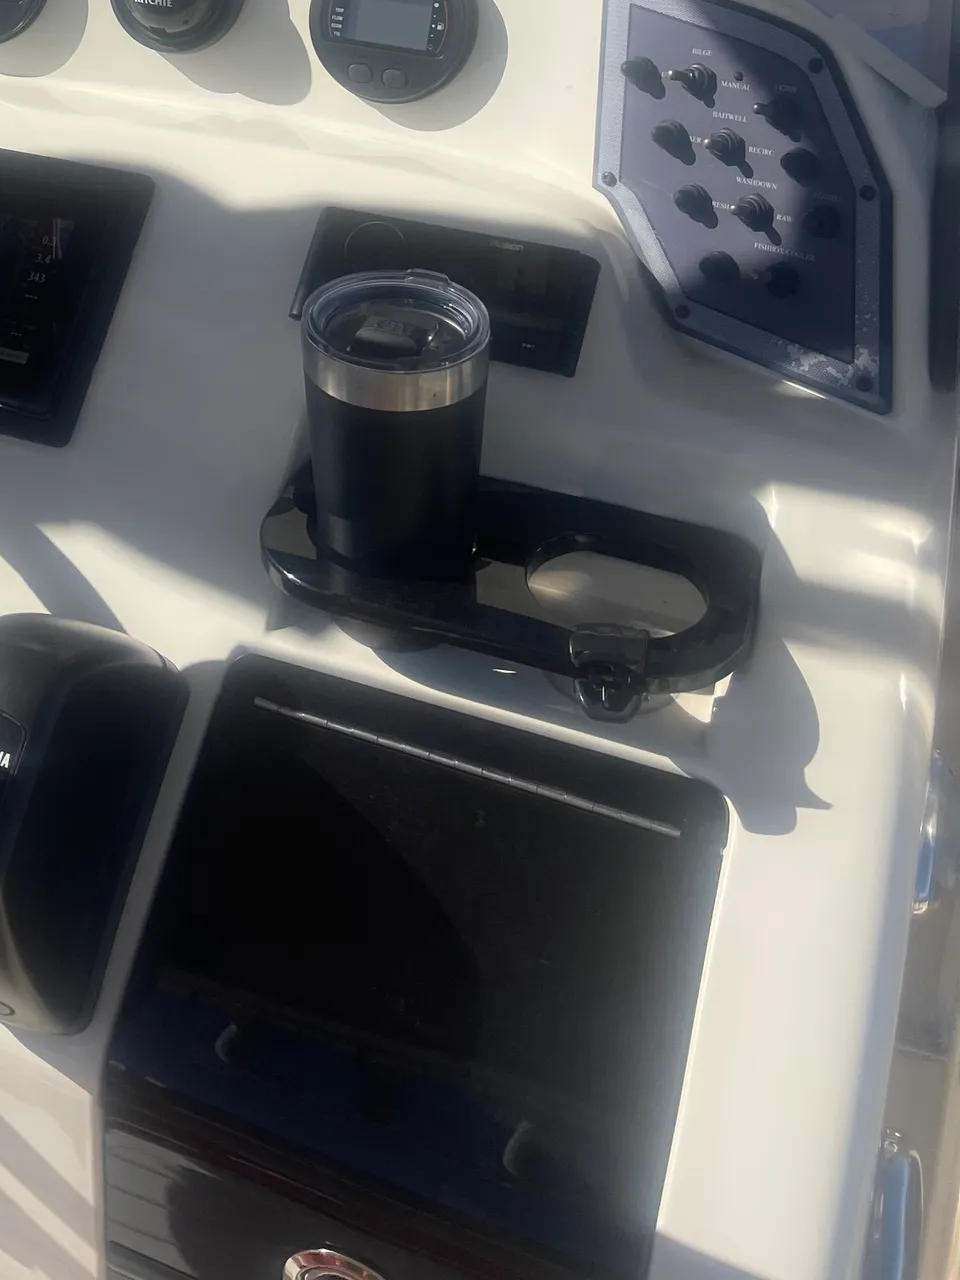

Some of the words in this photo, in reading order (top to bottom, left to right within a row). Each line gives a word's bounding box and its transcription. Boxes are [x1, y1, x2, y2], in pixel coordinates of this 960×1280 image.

[692, 48, 713, 57] BILGE
[721, 80, 751, 91] MANUAL
[712, 111, 748, 123] BAITWELL
[748, 146, 775, 156] RECIRC
[735, 176, 778, 190] WASHDOWN
[712, 200, 730, 210] RESH
[776, 213, 792, 223] RAW
[35, 253, 51, 264] 3.4
